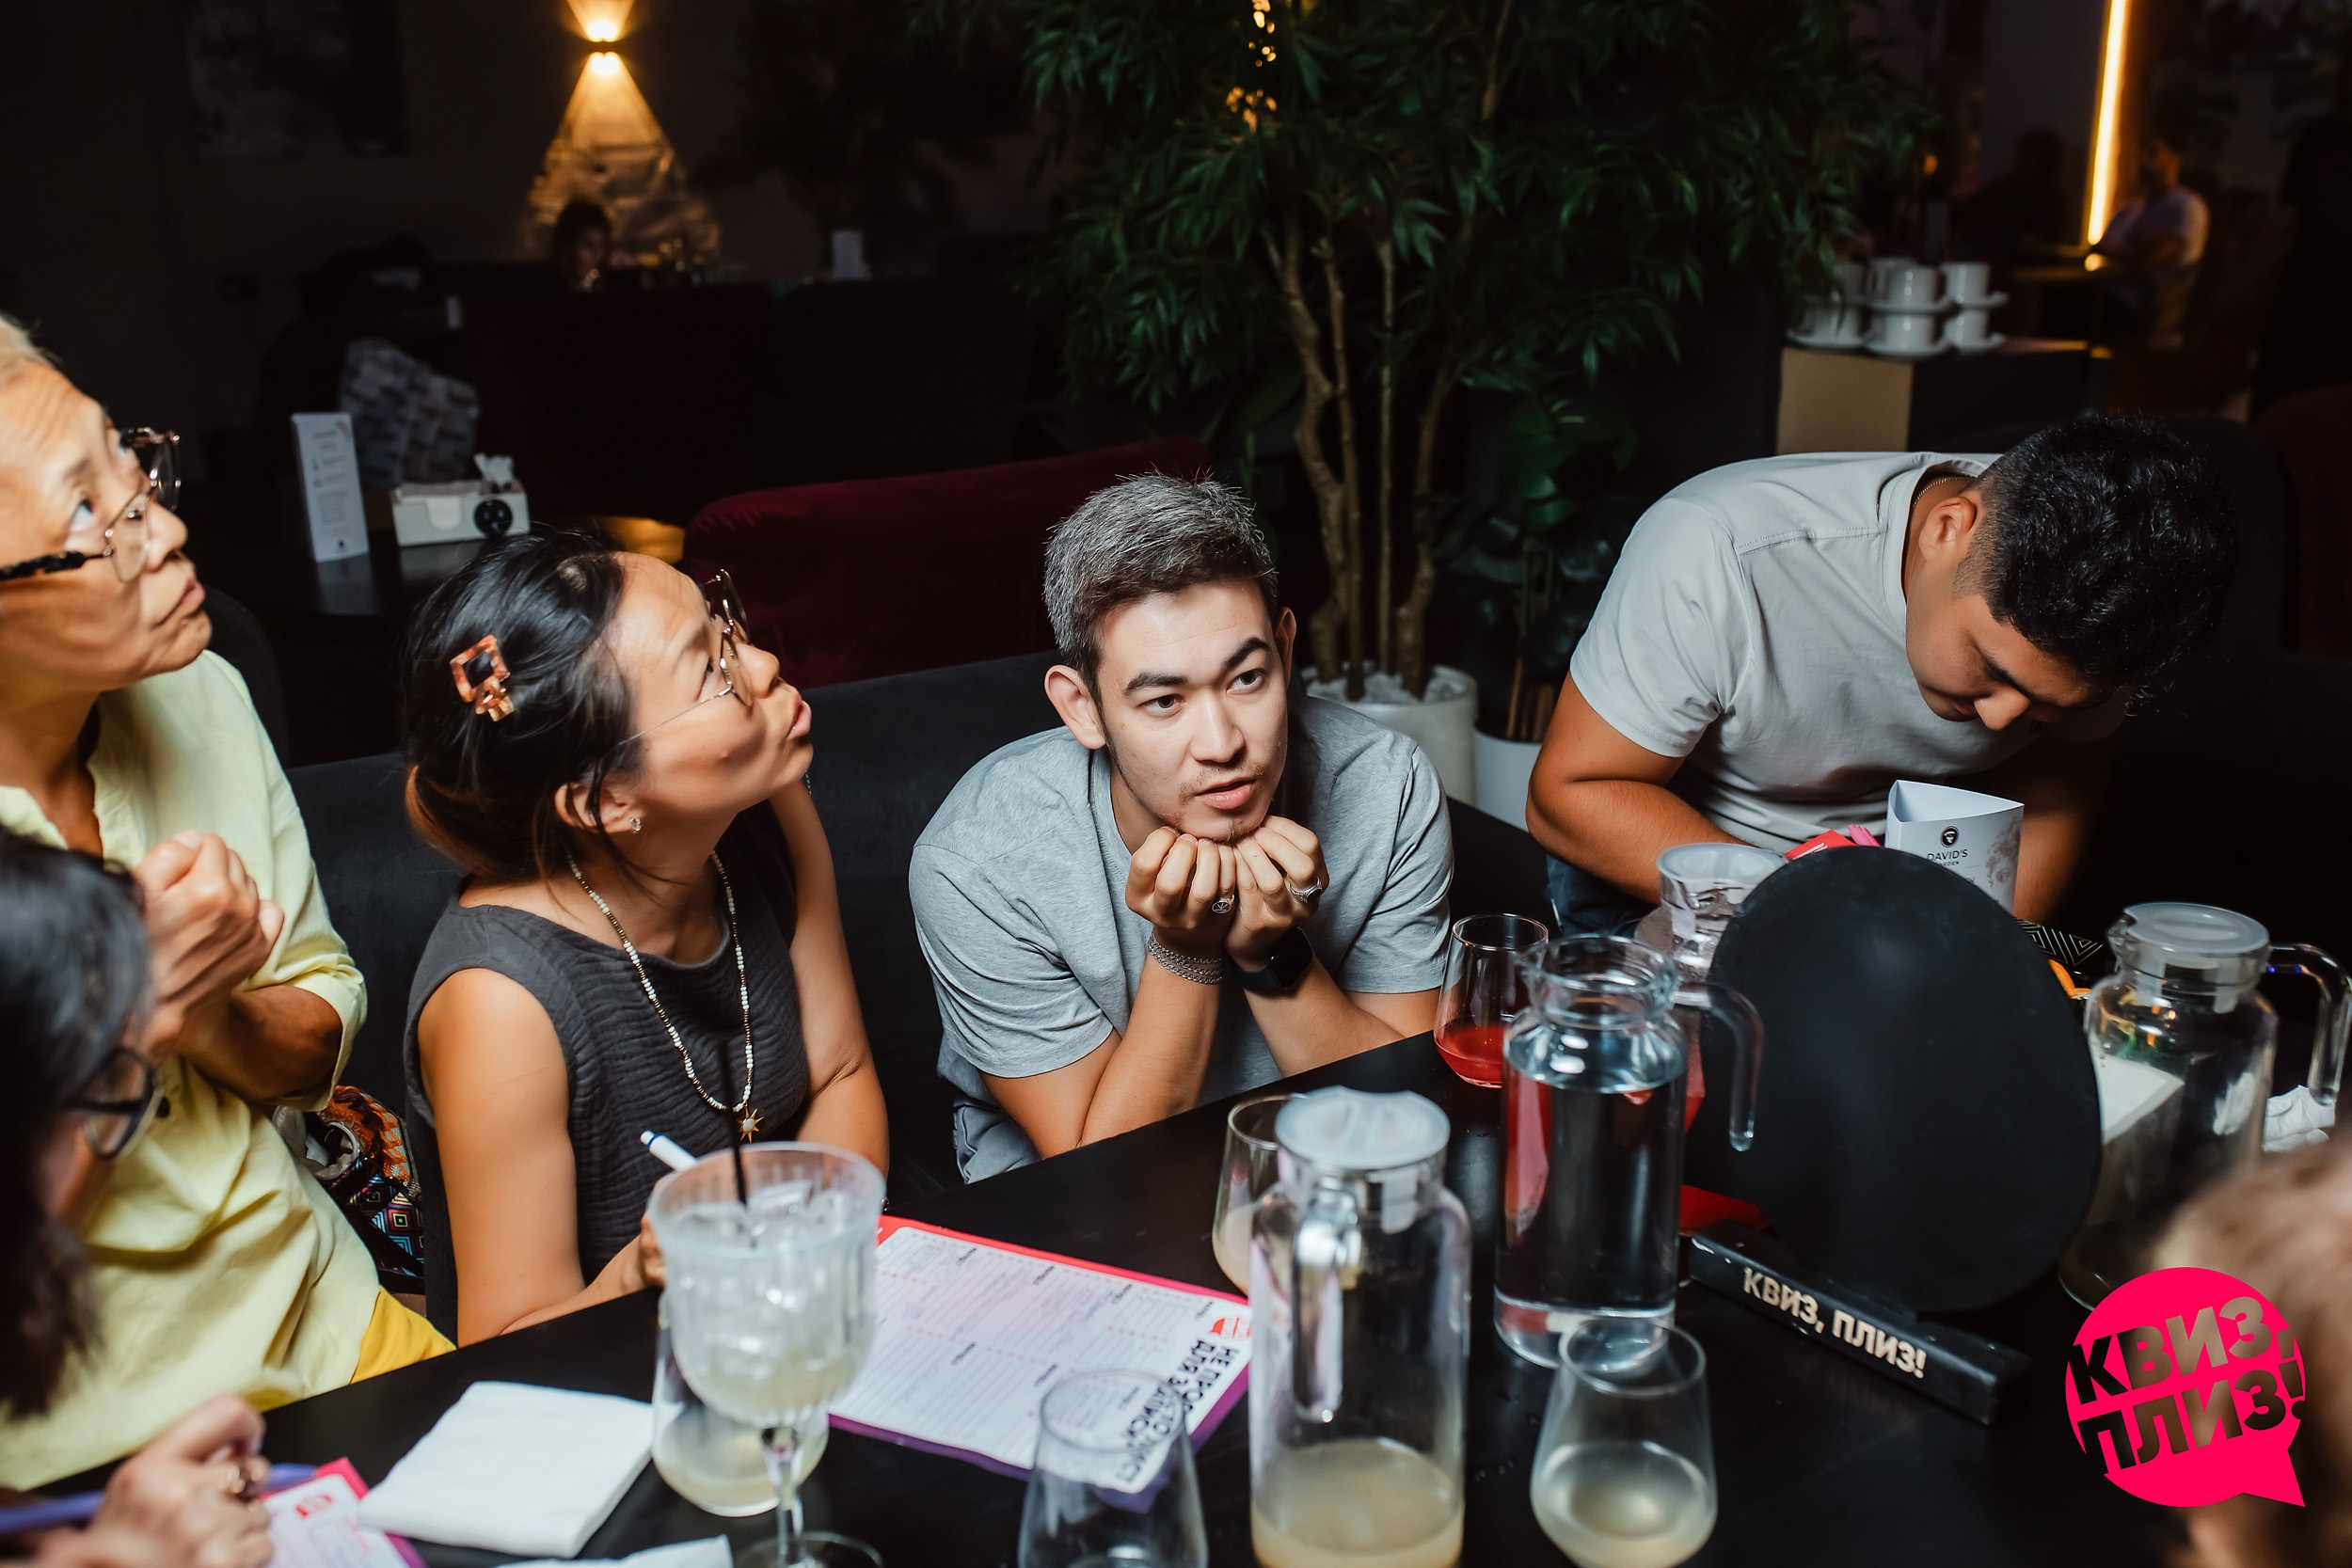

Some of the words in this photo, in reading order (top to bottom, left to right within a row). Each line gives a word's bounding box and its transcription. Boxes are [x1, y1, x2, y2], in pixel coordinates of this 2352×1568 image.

[1927, 848, 1968, 862] DAVID'S
[1743, 1267, 1825, 1334] КВИЗ,
[1832, 1308, 1927, 1379] ПЛИЗ!
[1178, 1338, 1215, 1374] ДЛЯ
